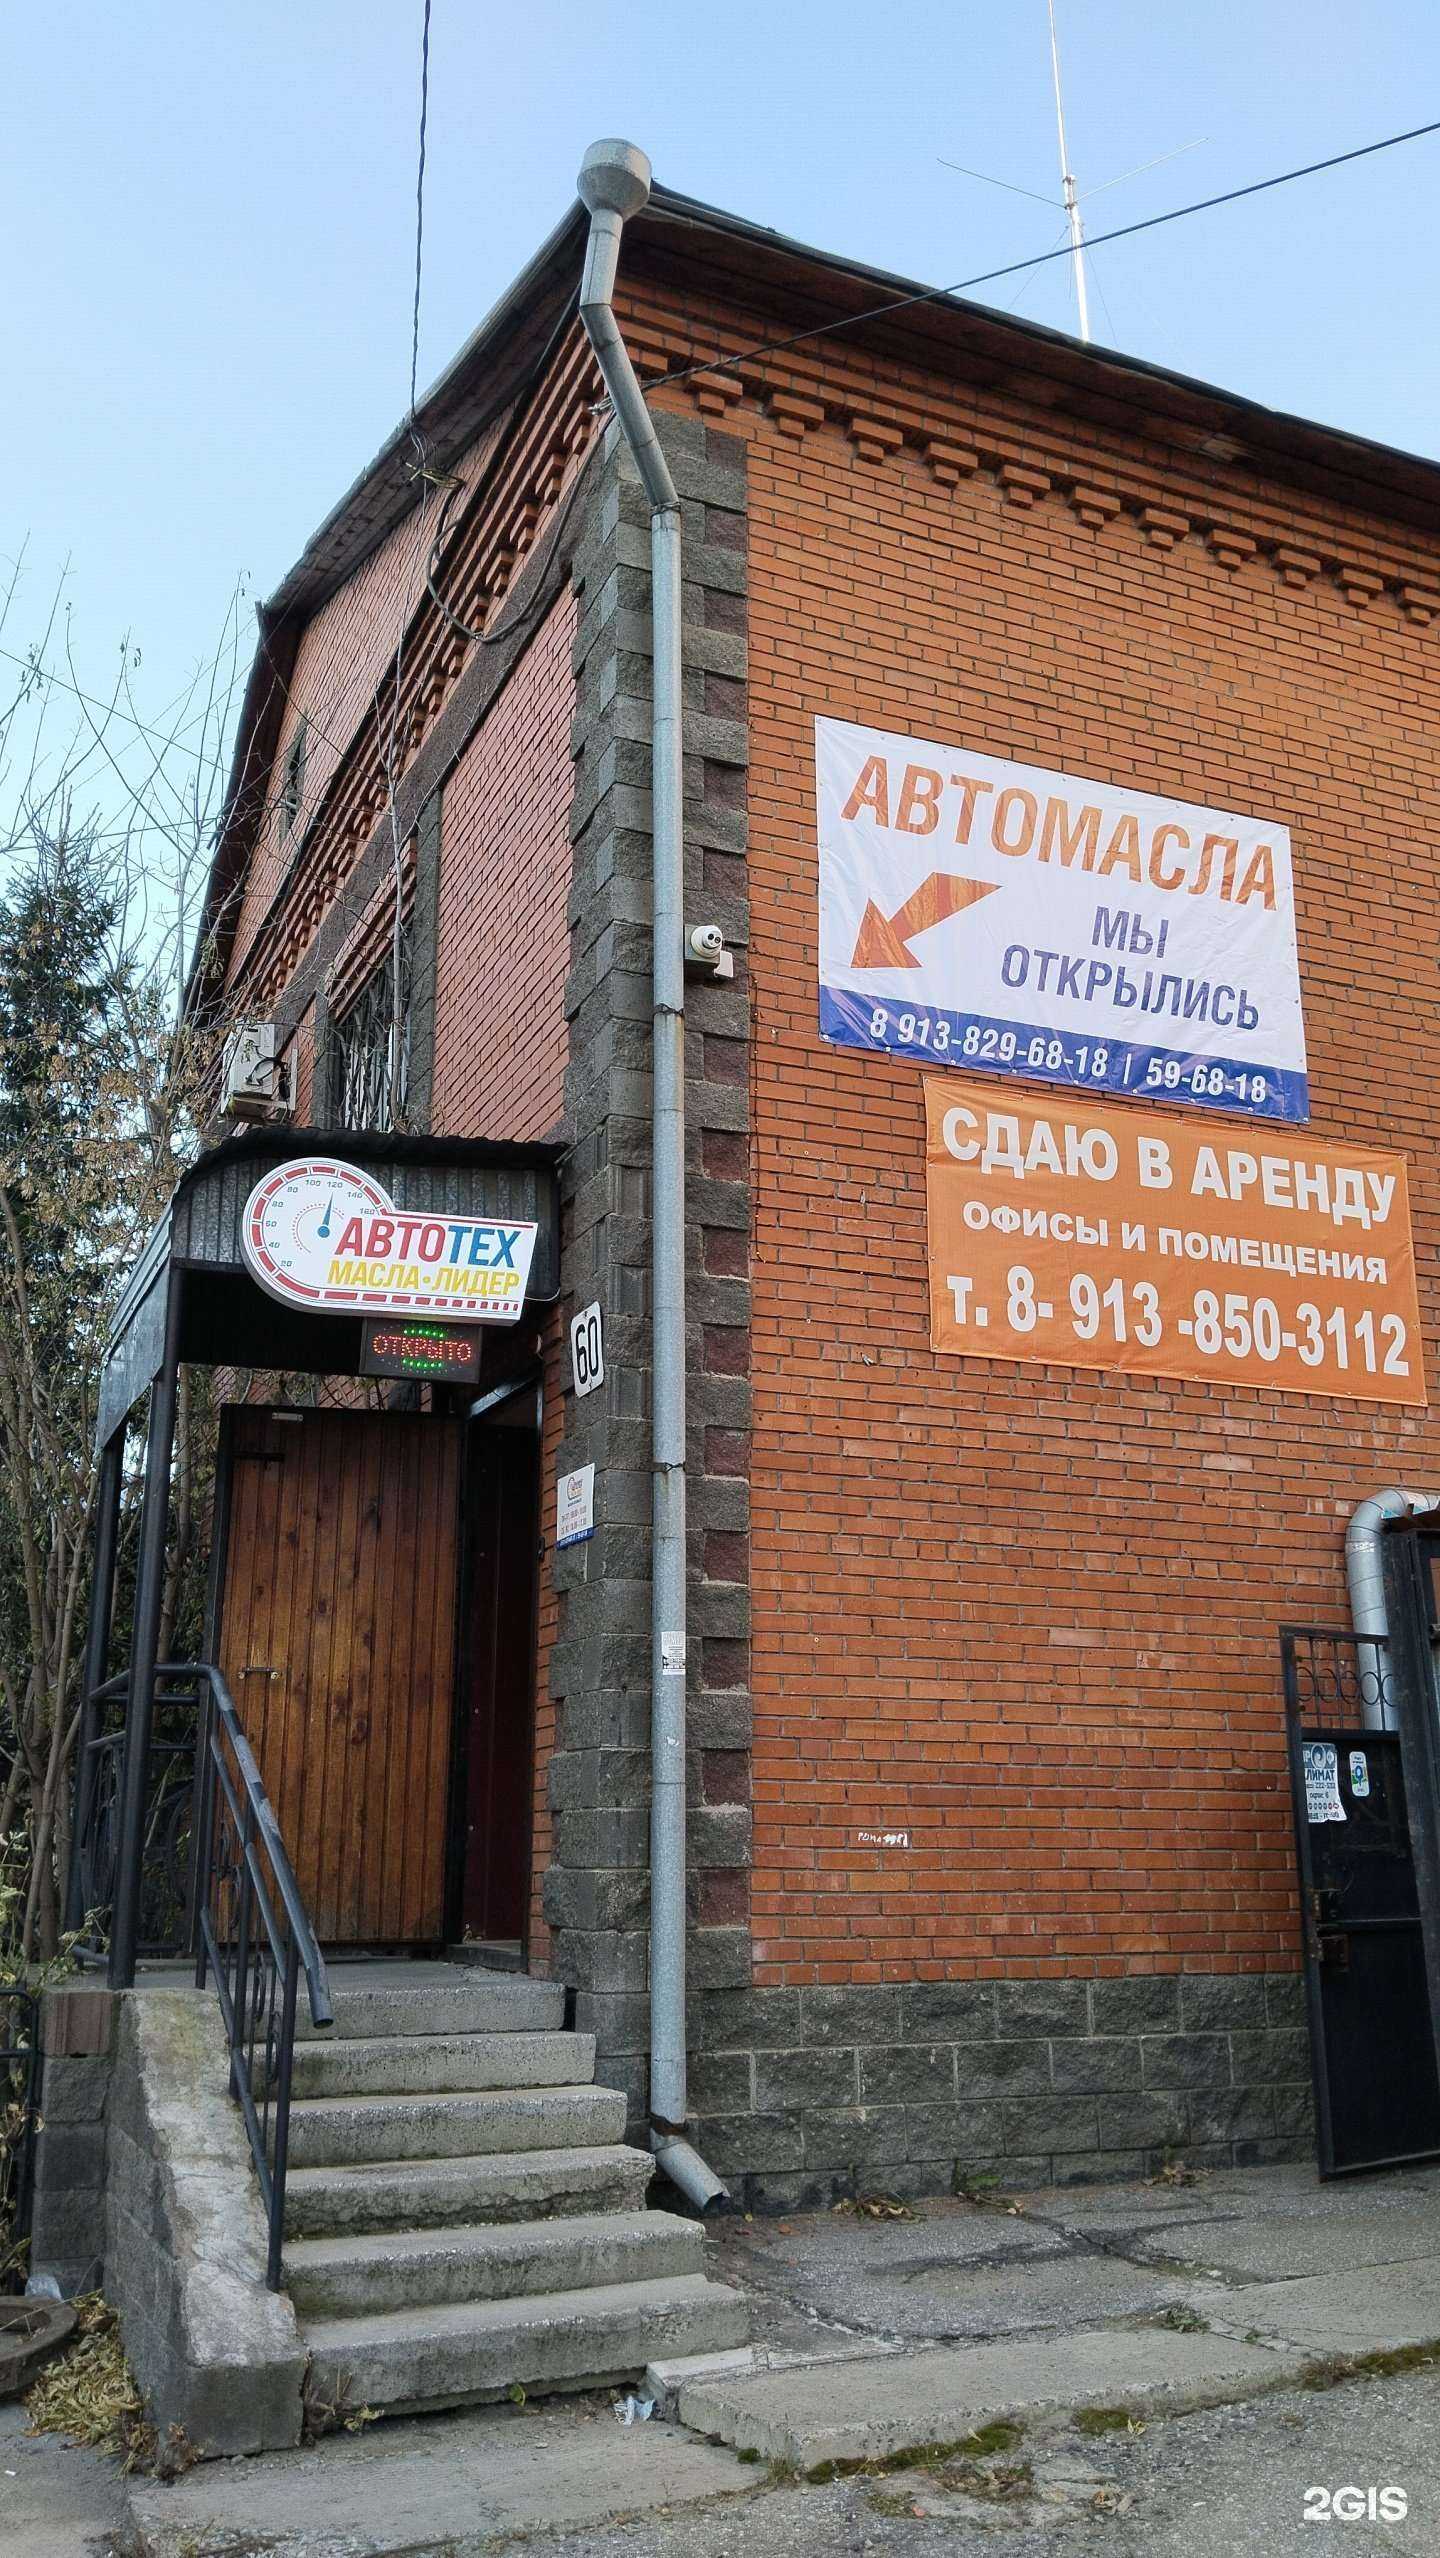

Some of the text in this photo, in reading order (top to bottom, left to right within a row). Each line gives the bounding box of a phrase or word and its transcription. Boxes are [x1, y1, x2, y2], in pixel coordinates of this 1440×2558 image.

[840, 755, 1278, 911] АВТОМАСЛА
[1091, 906, 1169, 958] МЫ
[1000, 944, 1260, 1031] ОТКРЫЛИСЬ
[869, 1008, 1267, 1103] 8 913-829-68-18 59-68-18
[942, 1107, 1396, 1230] СДАЮ В АРЕНДУ
[335, 1217, 521, 1268] АВТОТЕХ
[962, 1201, 1388, 1285] ОФИСЫ И ПОМЕЩЕНИЯ
[372, 1334, 472, 1361] ОТКРЫТО
[576, 1315, 599, 1384] 60
[1069, 1273, 1163, 1347] 913
